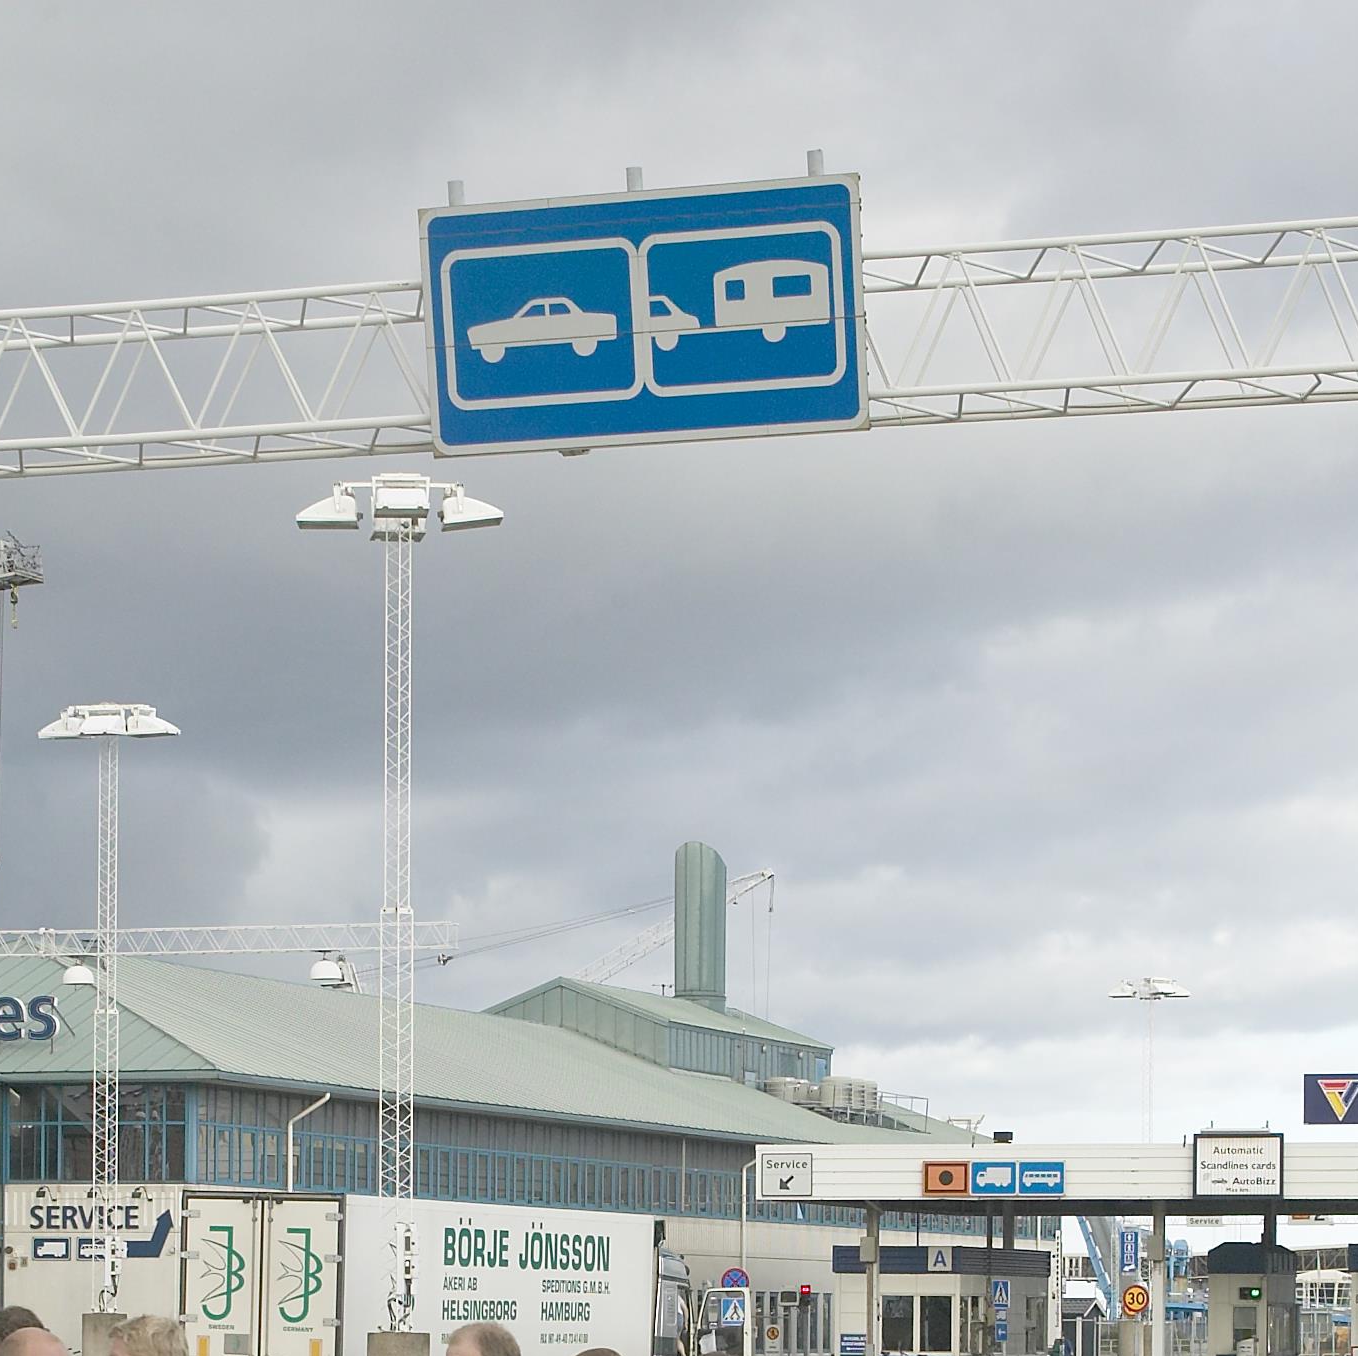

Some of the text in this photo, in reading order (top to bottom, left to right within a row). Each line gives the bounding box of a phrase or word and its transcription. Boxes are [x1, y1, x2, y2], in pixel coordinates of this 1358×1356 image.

[1213, 1146, 1264, 1155] Automatic
[766, 1159, 809, 1169] Service
[1200, 1160, 1276, 1170] Scandlines cards
[1232, 1177, 1276, 1185] AutoBizz
[30, 1204, 140, 1230] SERVICE
[442, 1217, 611, 1272] BÖRJE JÖNSSON
[932, 1249, 947, 1268] A
[442, 1273, 478, 1292] ÅKERI AB
[541, 1279, 582, 1294] SPEDITIONS
[1127, 1291, 1146, 1305] 30
[442, 1299, 518, 1321] HELSINGBORG
[541, 1301, 591, 1322] HAMBURG
[208, 1323, 235, 1331] SWEDEN
[282, 1325, 314, 1333] GERMANY
